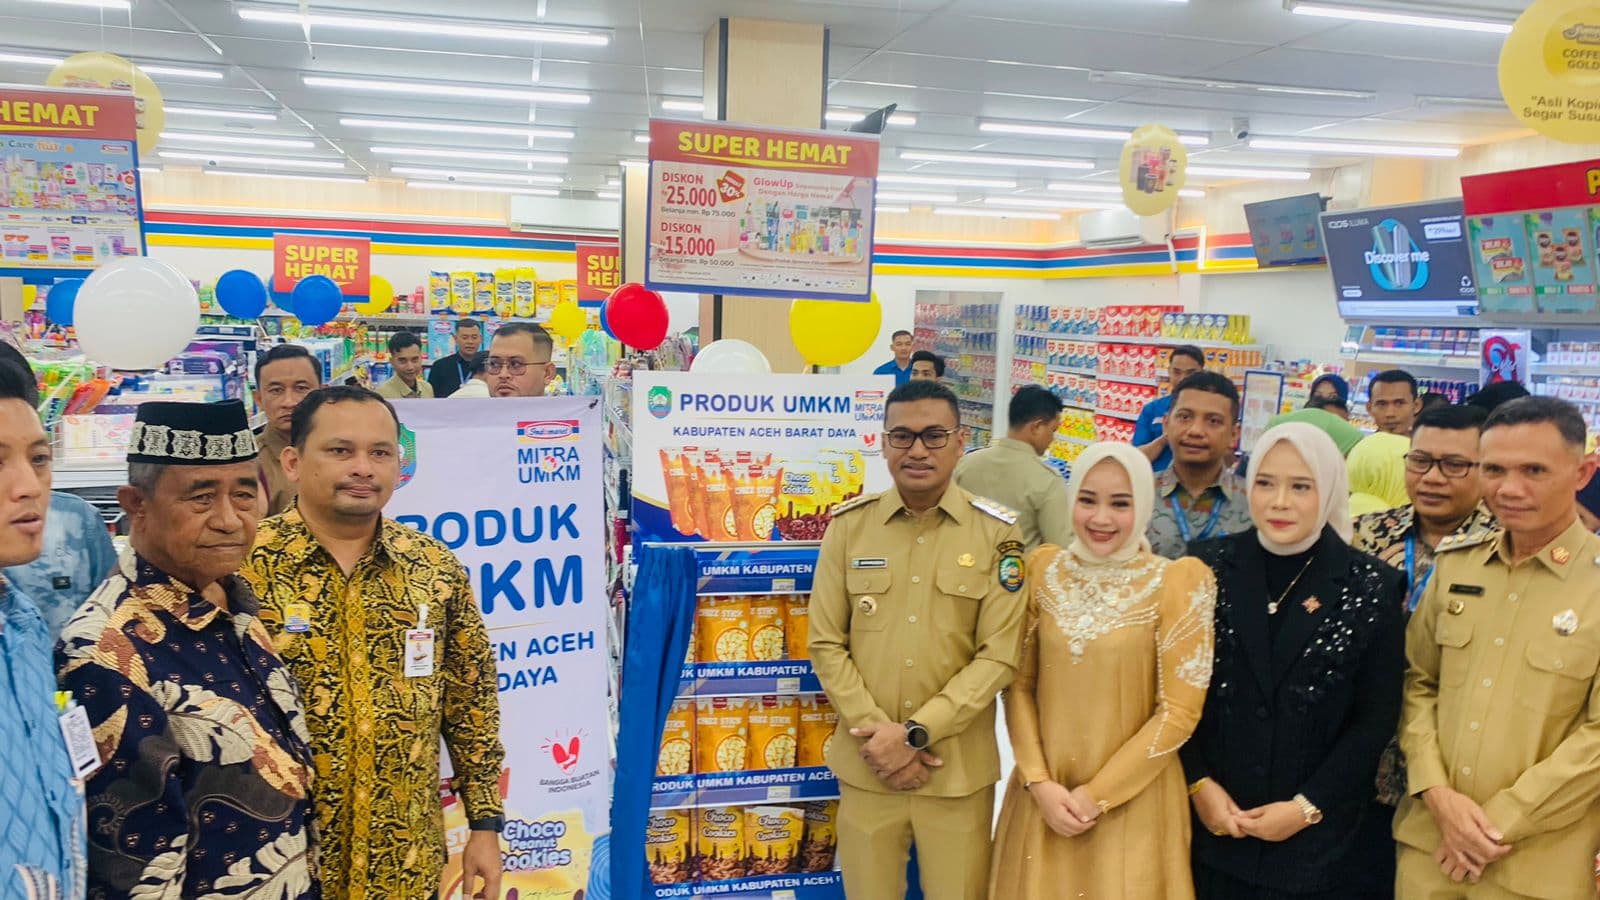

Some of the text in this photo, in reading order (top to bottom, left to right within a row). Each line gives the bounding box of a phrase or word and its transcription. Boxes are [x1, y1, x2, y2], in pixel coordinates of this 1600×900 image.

[1523, 107, 1563, 121] Segar
[678, 131, 852, 165] SUPER HEMAT
[662, 172, 703, 185] DISKON
[753, 177, 793, 189] GlowUp
[667, 185, 717, 208] 25.000
[660, 222, 702, 234] DISKON
[665, 235, 715, 257] 15.000
[285, 245, 359, 264] SUPER
[1364, 251, 1430, 264] Discover me
[680, 393, 850, 414] PRODUK UMKM
[673, 426, 857, 438] KABUPATEN ACEH BARAT DAYA
[518, 446, 580, 465] MITRA
[518, 464, 581, 484] UMKM
[702, 564, 812, 576] UMKM KABUPATEN
[526, 631, 594, 658] ACEH
[497, 666, 558, 692] DAYA
[697, 667, 734, 678] UMKM
[737, 665, 808, 677] KABUPATEN
[696, 777, 733, 788] UMKM
[736, 773, 805, 786] KABUPATEN
[704, 809, 737, 822] Choco
[758, 815, 790, 826] Choco
[502, 819, 566, 841] Choco
[510, 839, 557, 851] Peanut
[655, 876, 834, 898] ODUK UMKM KABUPATEN ACEH
